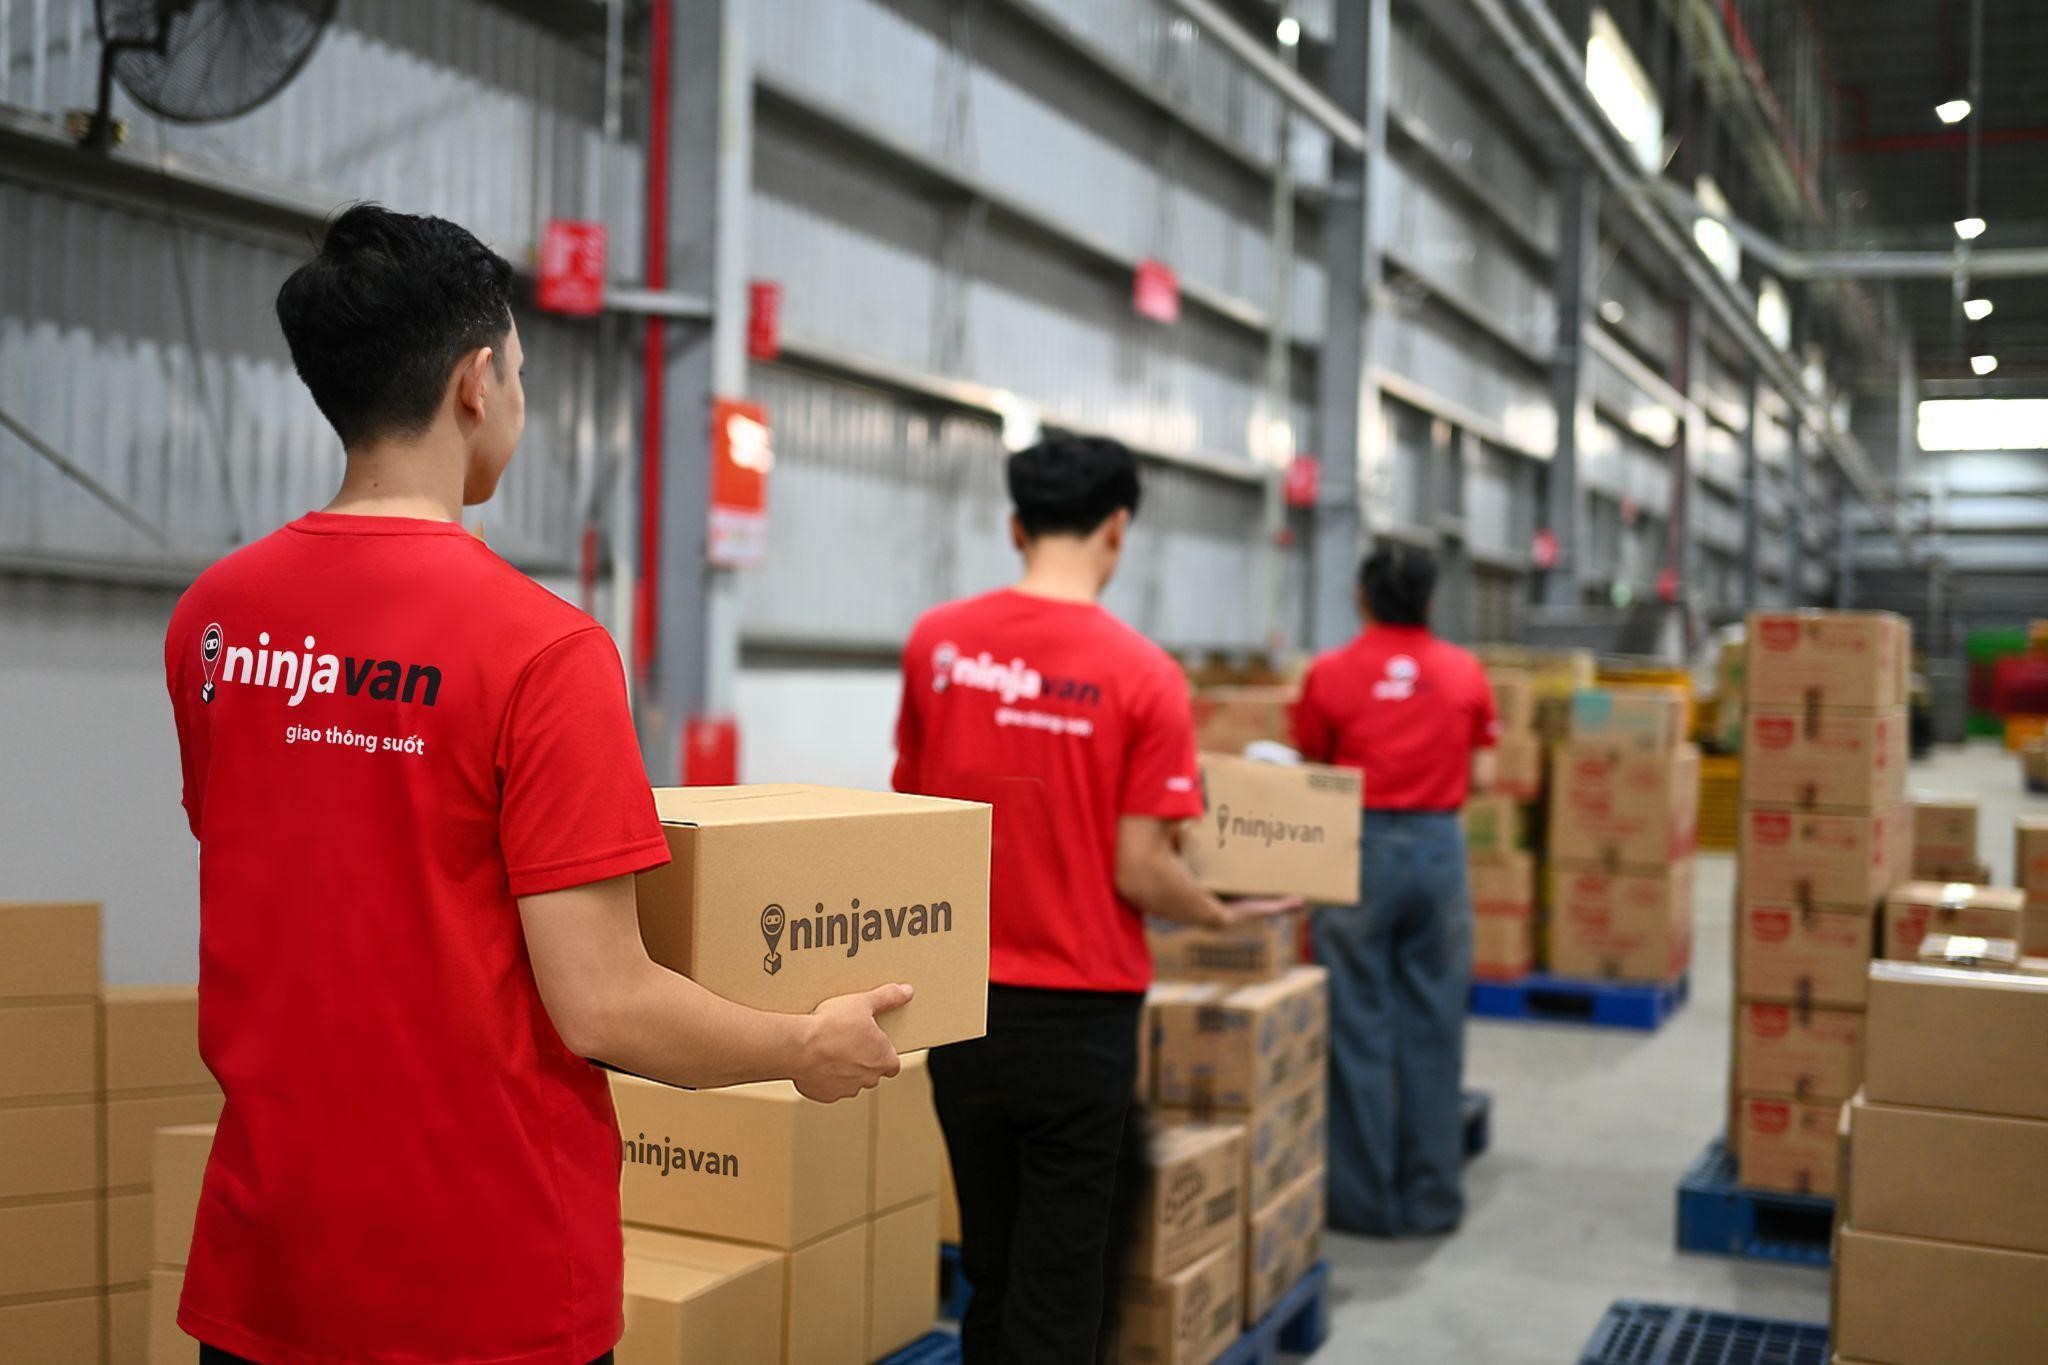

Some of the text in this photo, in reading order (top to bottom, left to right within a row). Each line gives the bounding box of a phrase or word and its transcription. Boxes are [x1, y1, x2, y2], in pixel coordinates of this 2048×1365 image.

[222, 632, 442, 707] ninjavan
[286, 724, 425, 755] giao thông suốt
[1232, 810, 1325, 848] ninjavan
[790, 898, 952, 958] ninjavan
